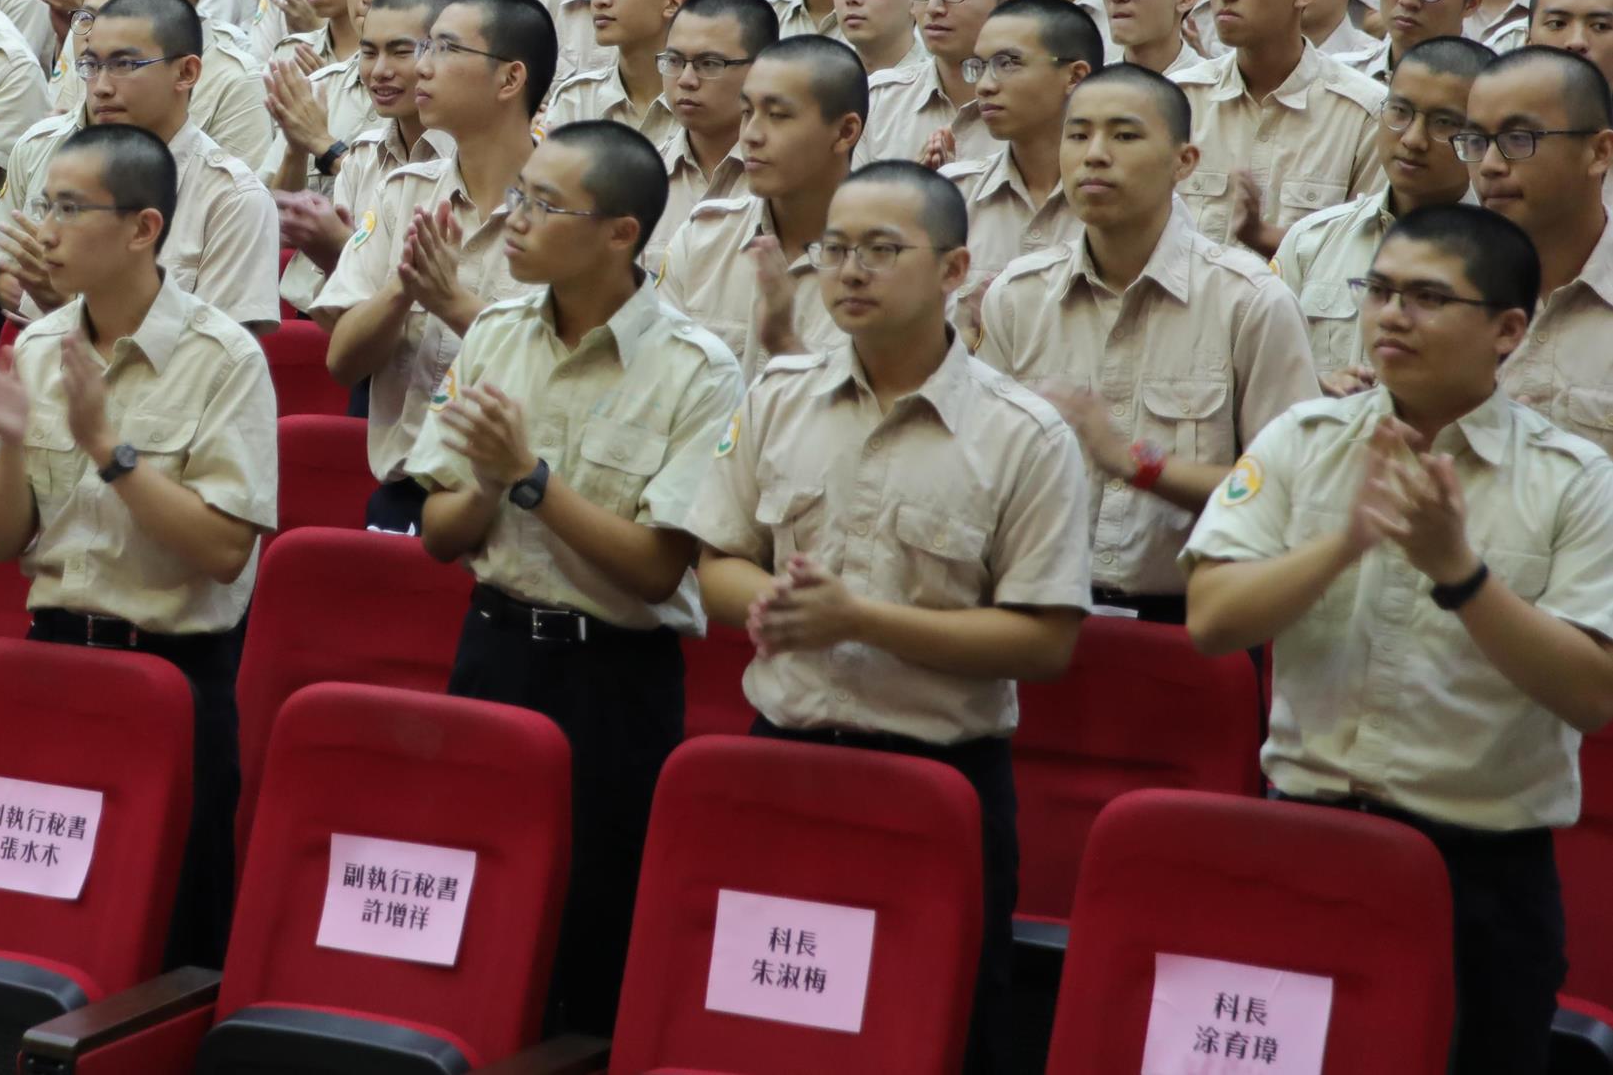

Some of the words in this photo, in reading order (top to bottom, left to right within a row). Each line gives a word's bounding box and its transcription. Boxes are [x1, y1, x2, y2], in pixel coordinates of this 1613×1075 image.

[0, 836, 61, 867] 張水木
[342, 862, 459, 902] 副執行秘書
[361, 898, 431, 931] 許增祥
[768, 926, 818, 958] 科長
[750, 959, 828, 995] 朱淑梅
[1213, 991, 1268, 1026] 科長
